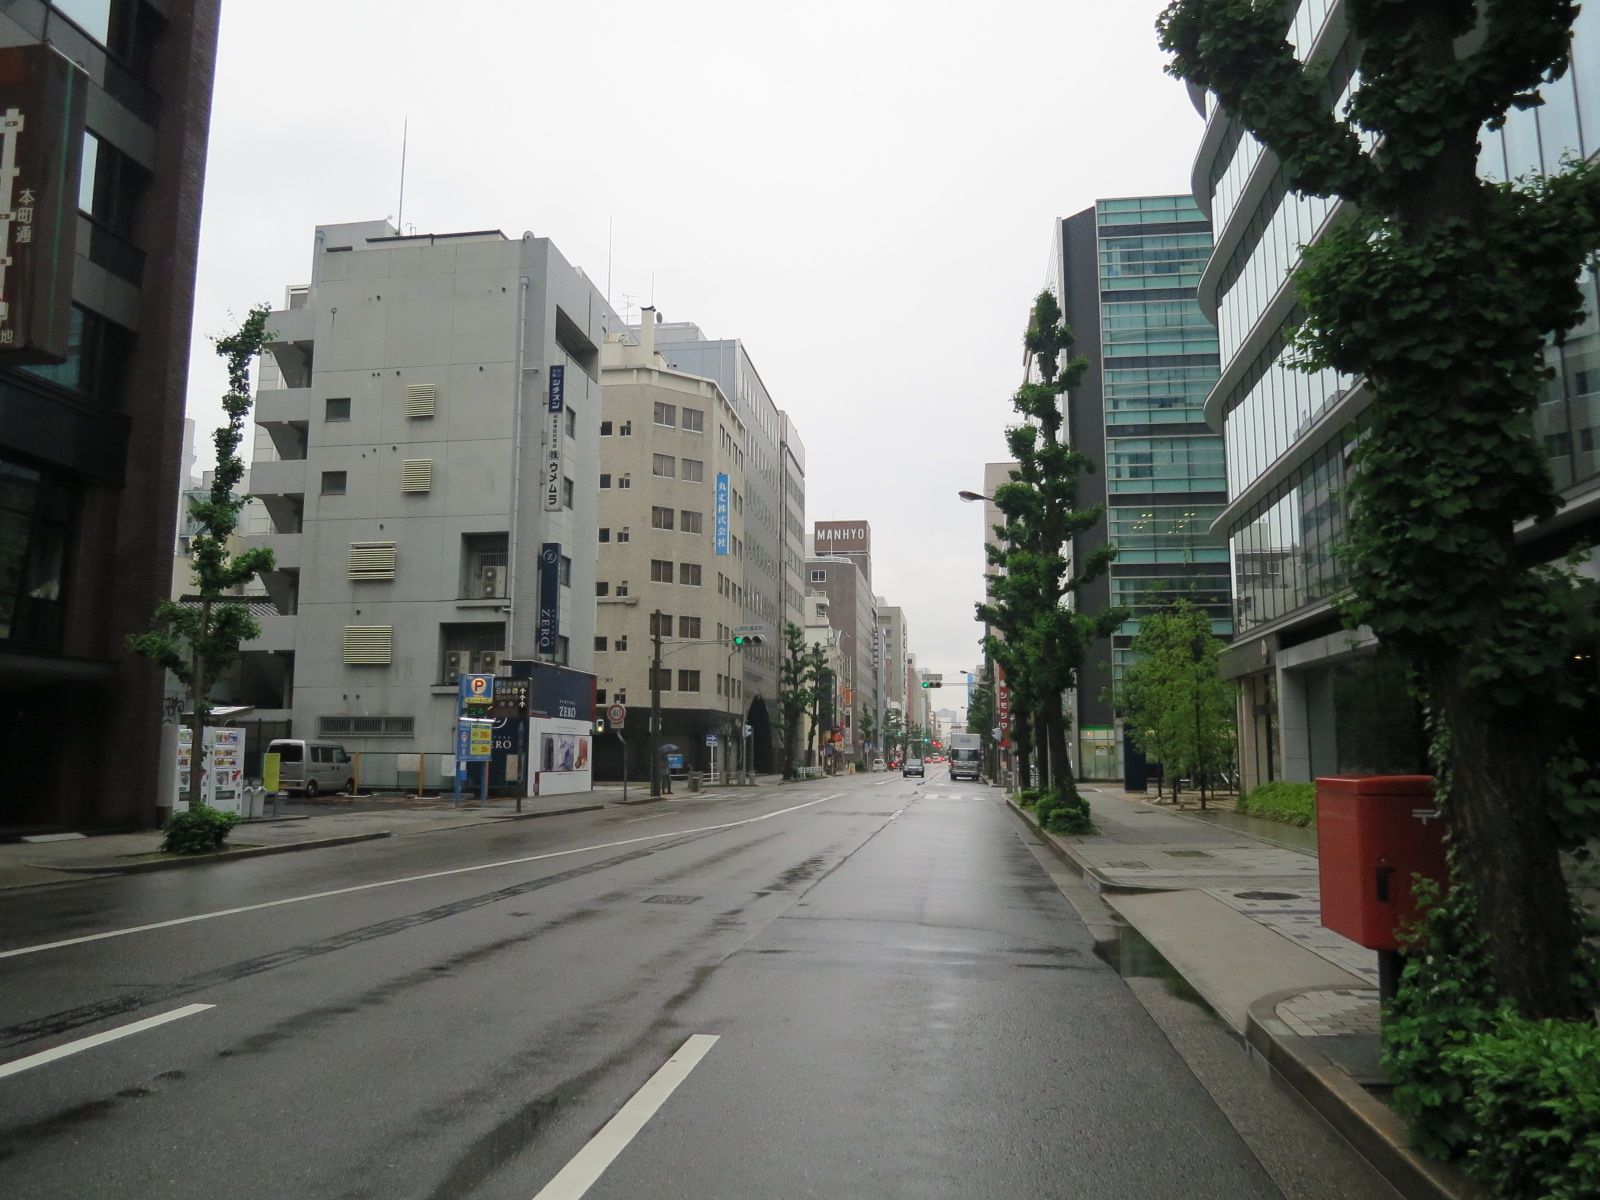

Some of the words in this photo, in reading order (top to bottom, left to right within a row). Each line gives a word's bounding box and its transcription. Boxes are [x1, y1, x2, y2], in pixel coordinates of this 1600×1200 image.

[15, 187, 35, 244] 本町通
[817, 528, 865, 541] MANHYO
[540, 608, 551, 647] ZERO
[474, 679, 485, 693] P
[559, 705, 576, 718] ZERO
